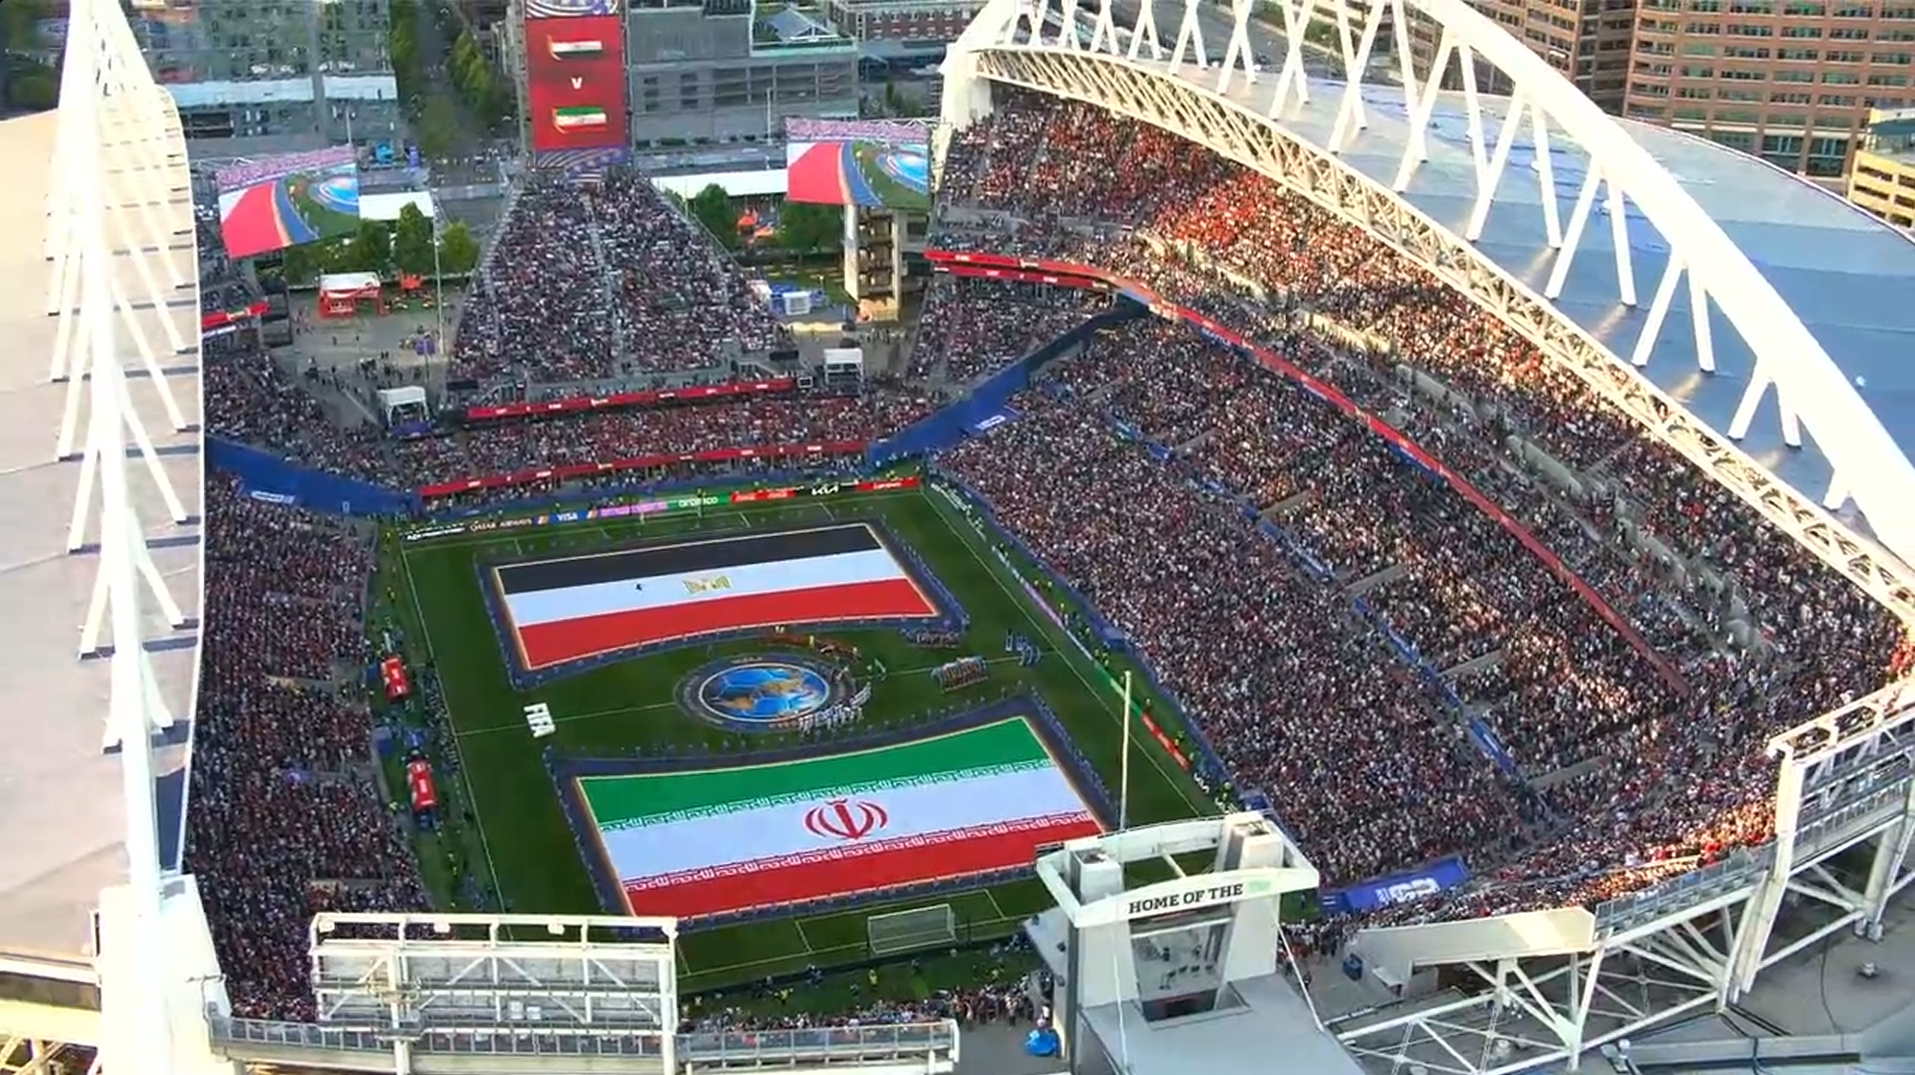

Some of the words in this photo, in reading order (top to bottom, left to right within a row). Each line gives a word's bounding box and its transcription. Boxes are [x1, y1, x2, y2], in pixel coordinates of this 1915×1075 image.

[470, 521, 497, 533] QATAR
[499, 518, 533, 528] AIRWAYS
[557, 513, 579, 522] VISA
[523, 702, 556, 738] FIFA
[1128, 894, 1180, 914] HOME
[1183, 890, 1205, 904] OF
[1208, 883, 1244, 900] THE
